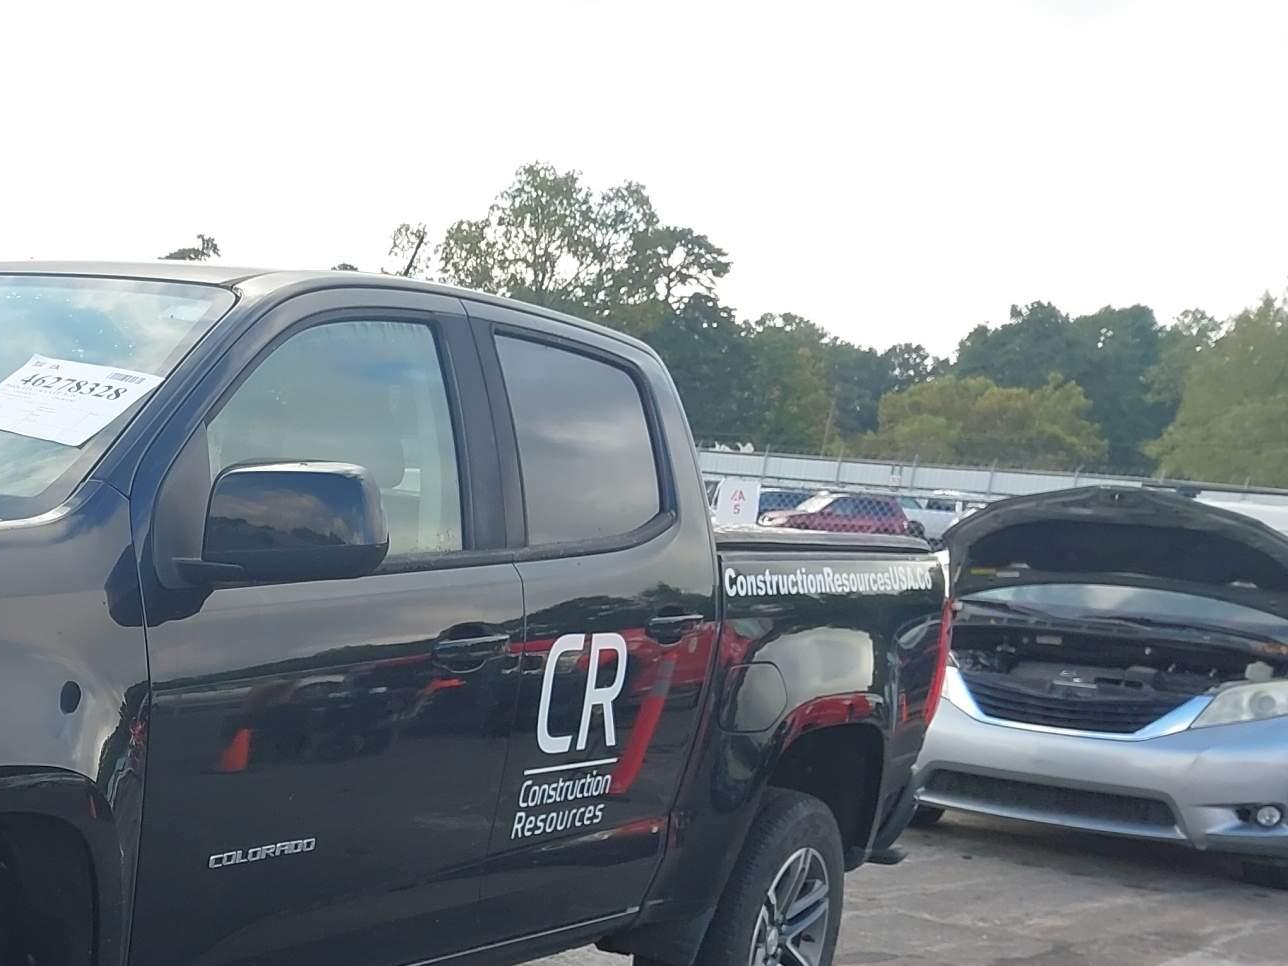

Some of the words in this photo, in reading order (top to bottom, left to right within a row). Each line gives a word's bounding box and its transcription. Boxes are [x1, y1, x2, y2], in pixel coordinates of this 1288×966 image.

[20, 372, 128, 401] 46278328
[537, 632, 628, 754] CR
[519, 770, 612, 809] Construction
[511, 803, 606, 840] Resources
[208, 837, 316, 869] COLORADO
